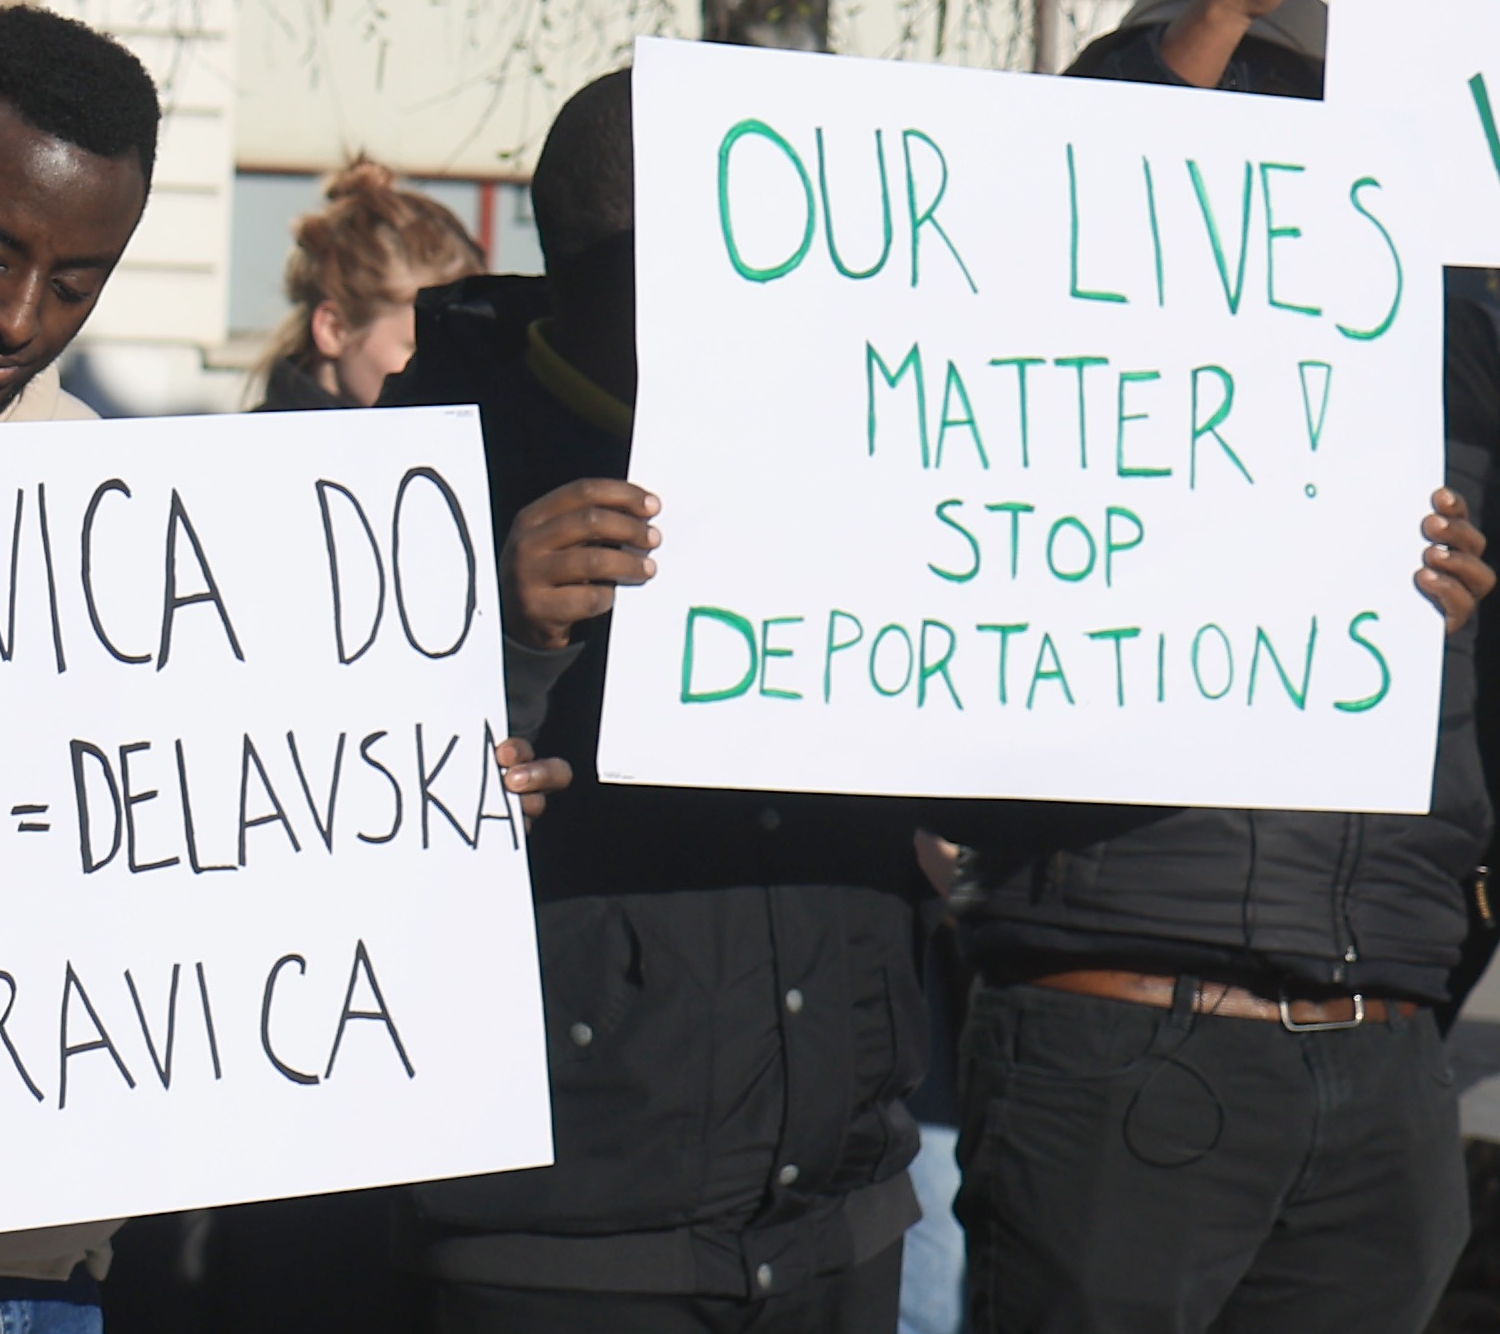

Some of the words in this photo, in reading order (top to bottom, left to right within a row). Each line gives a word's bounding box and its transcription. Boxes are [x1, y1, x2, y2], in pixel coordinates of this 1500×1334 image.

[717, 118, 979, 294] OUR
[1066, 143, 1404, 342] LIVES
[314, 466, 477, 666] DO
[928, 498, 1145, 588] STOP
[680, 605, 1392, 714] DEPORTATIONS
[69, 719, 518, 875] DELAVSKA
